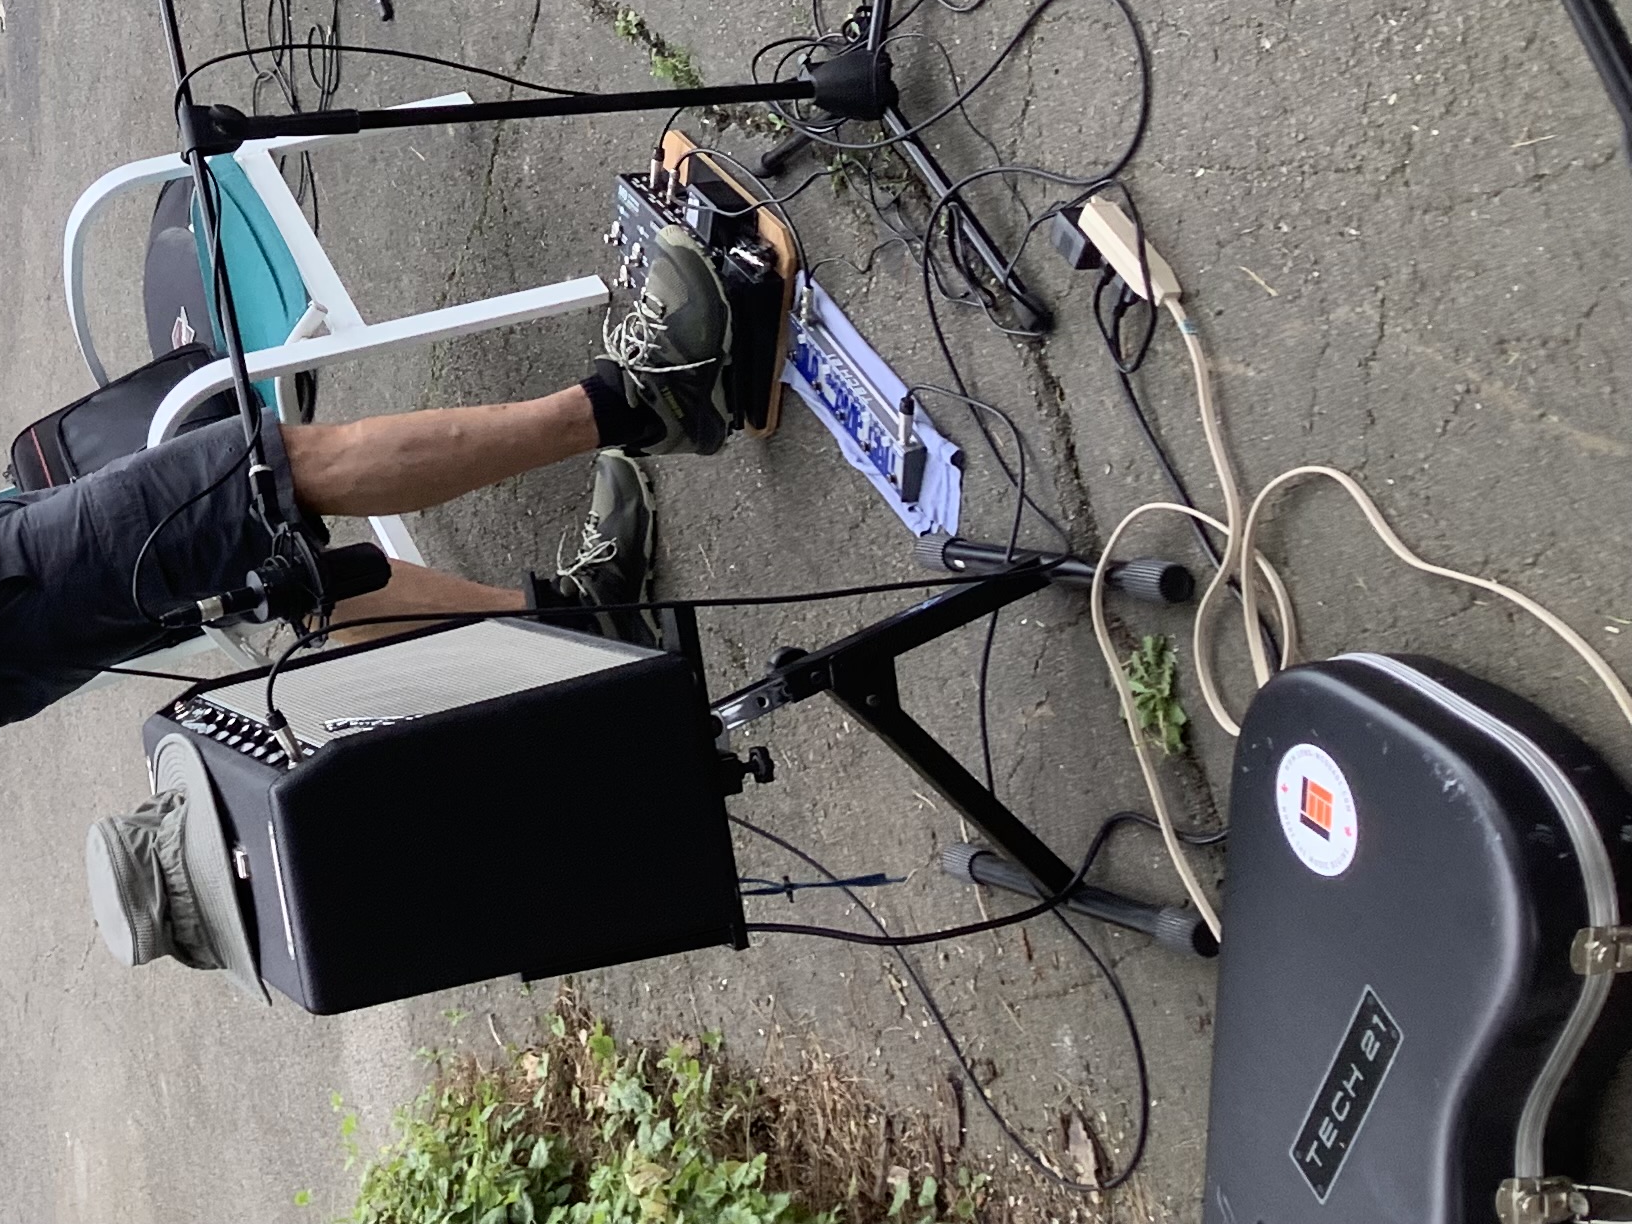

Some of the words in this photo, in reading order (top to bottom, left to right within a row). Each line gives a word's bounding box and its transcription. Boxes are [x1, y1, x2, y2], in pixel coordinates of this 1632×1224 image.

[836, 368, 873, 405] TECH
[1305, 1063, 1364, 1168] TECH
[1361, 1014, 1388, 1061] 21
